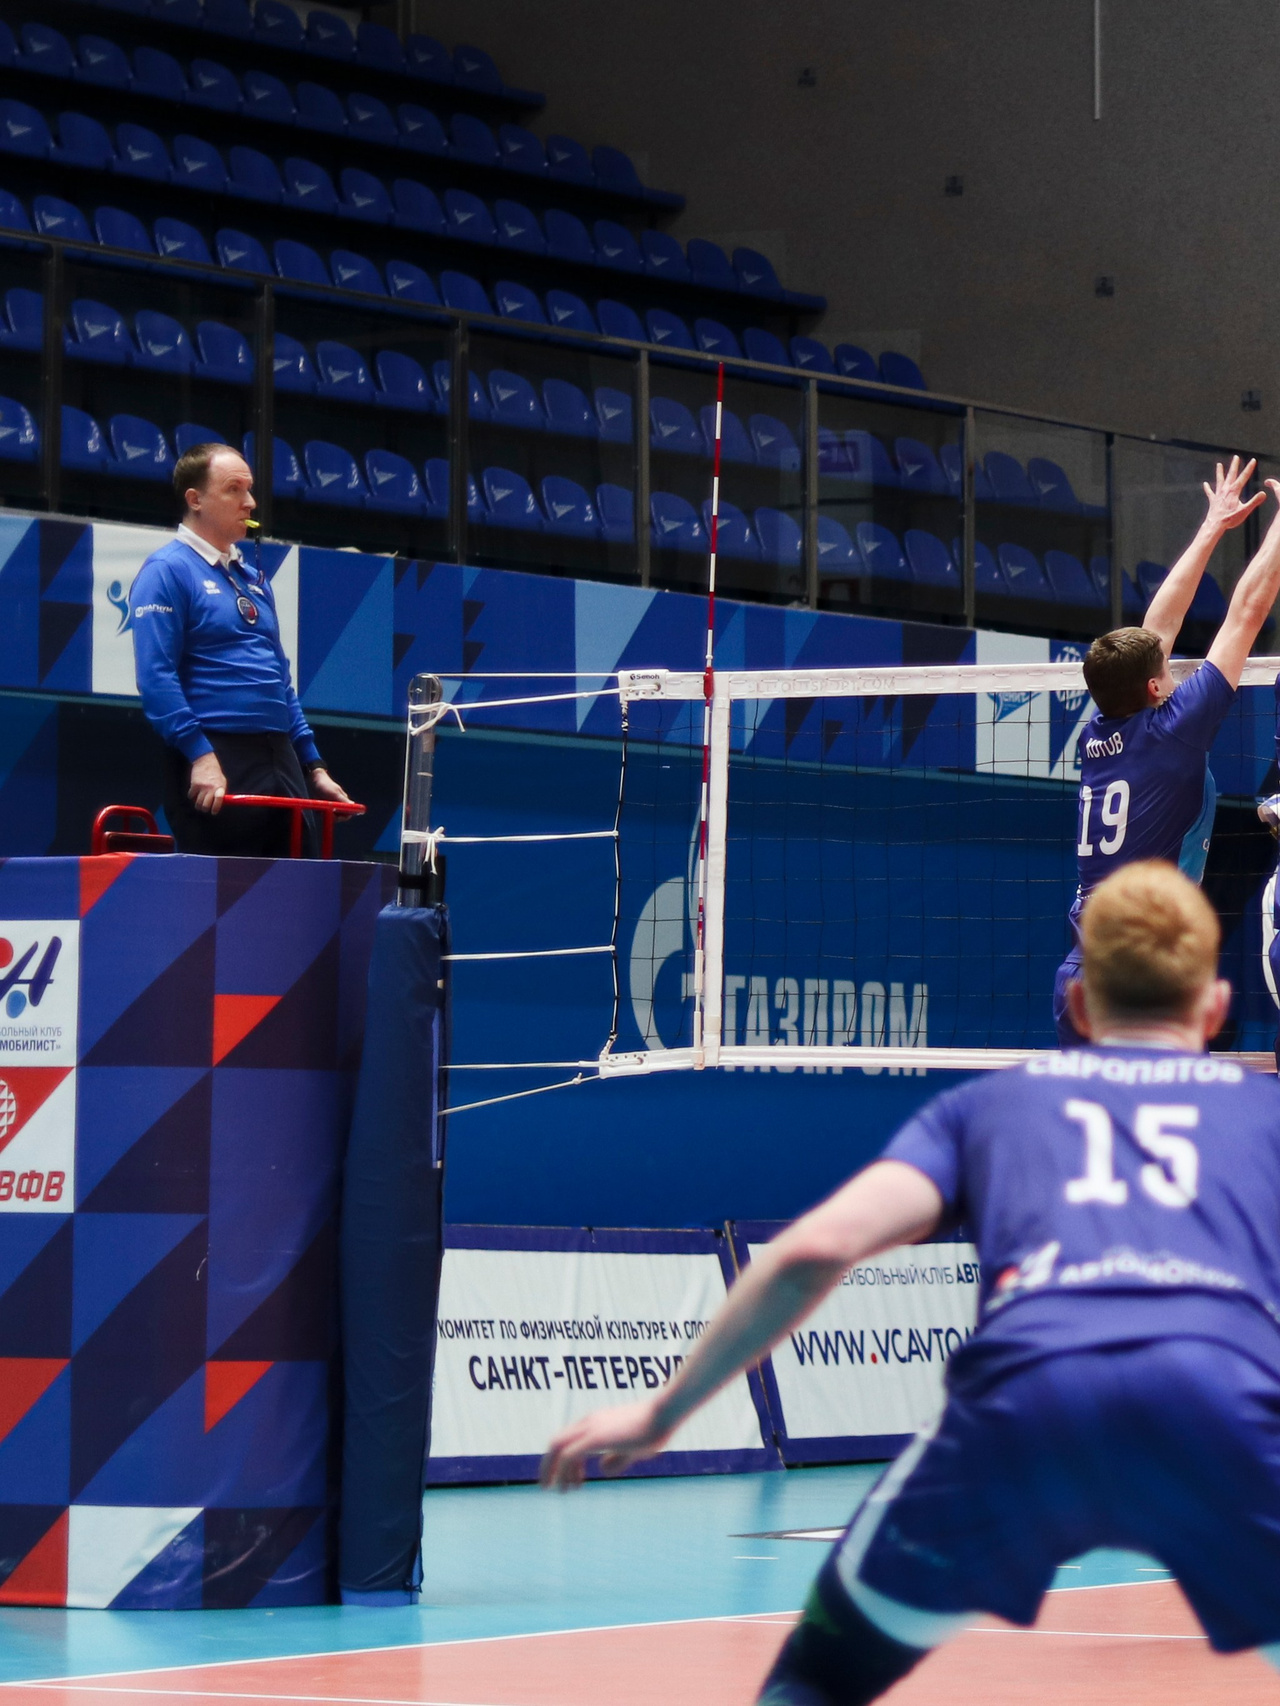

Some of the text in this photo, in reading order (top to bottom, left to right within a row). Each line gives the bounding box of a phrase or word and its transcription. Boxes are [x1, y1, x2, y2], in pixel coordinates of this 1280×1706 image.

[1077, 779, 1130, 857] 19
[40, 1026, 63, 1037] КЛУБ
[724, 975, 928, 1077] ГАЗПРОМ
[1064, 1099, 1200, 1208] 15
[921, 1267, 955, 1285] КЛУБ
[437, 1319, 495, 1339] КОМИТЕТ
[500, 1320, 517, 1339] ПО
[520, 1315, 604, 1340] ФИЗИЧЕСКОЙ
[606, 1320, 668, 1340] КУЛЬТУРЕ
[669, 1321, 682, 1339] И
